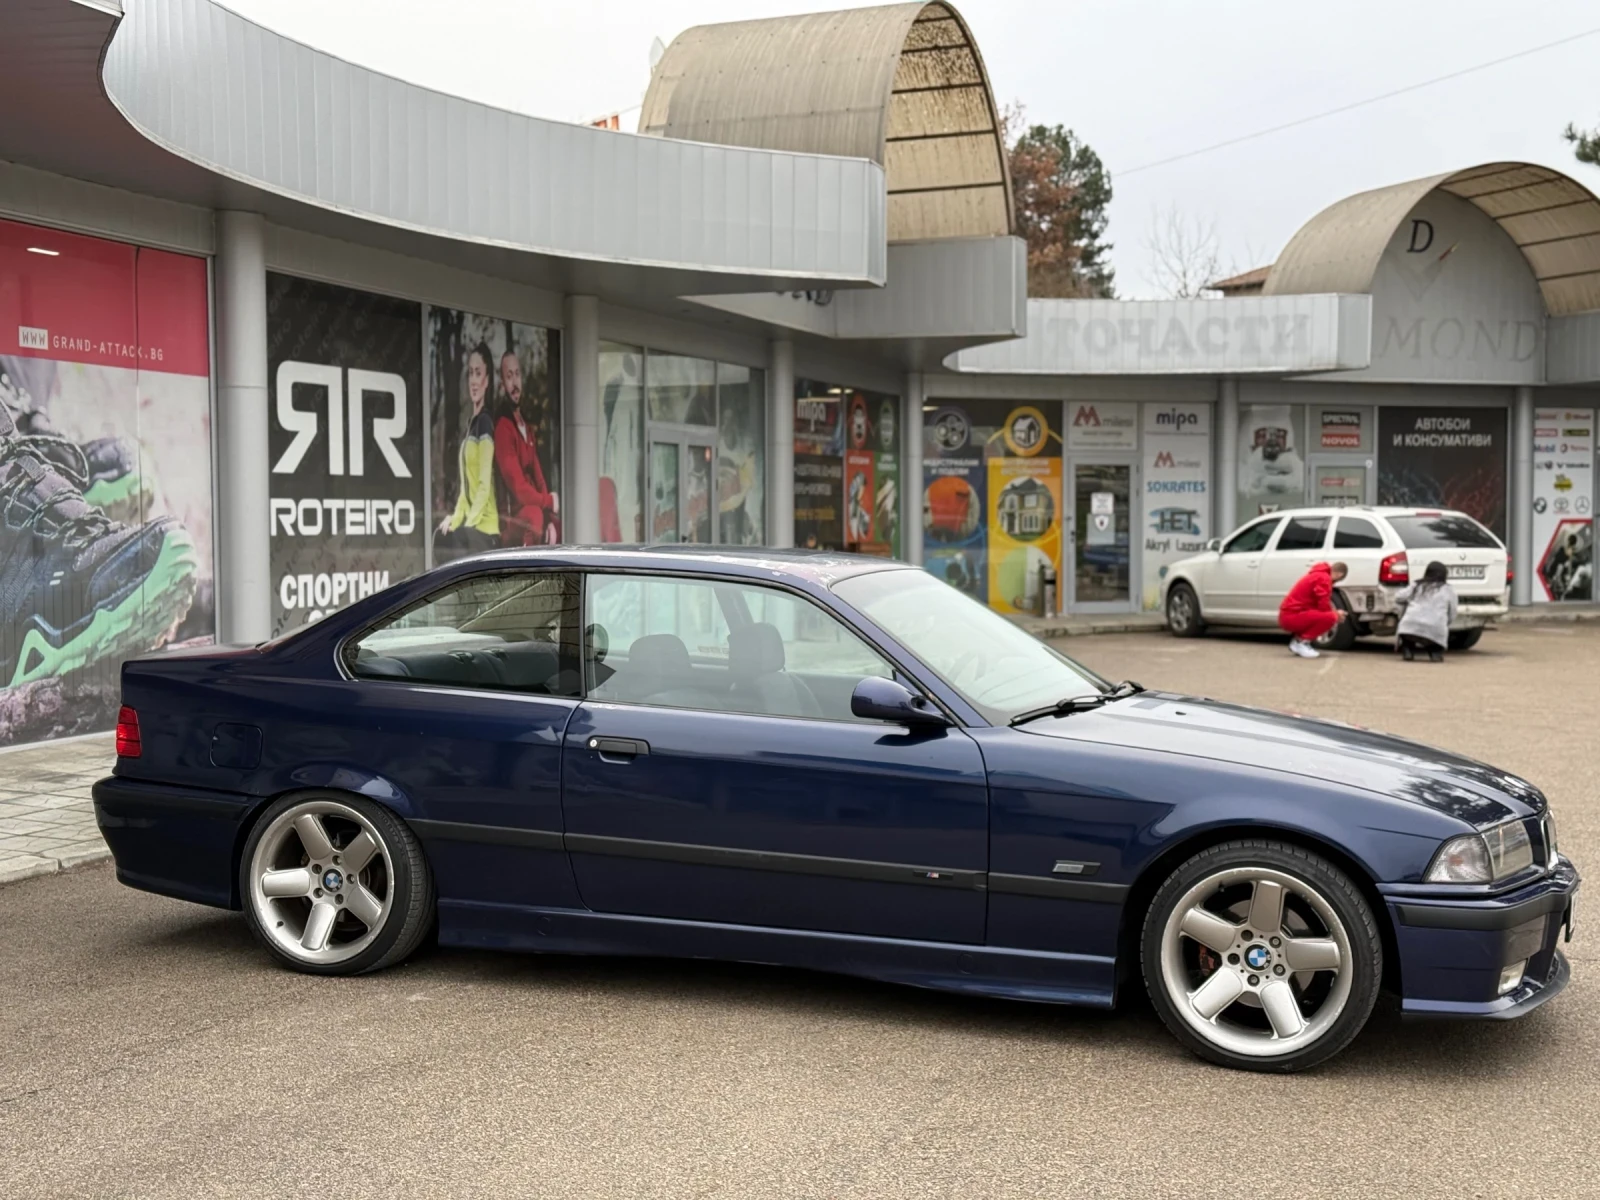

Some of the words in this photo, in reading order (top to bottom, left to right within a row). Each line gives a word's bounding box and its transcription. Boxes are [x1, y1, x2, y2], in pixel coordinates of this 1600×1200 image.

[1406, 219, 1435, 253] D
[22, 330, 46, 346] WWW
[1156, 408, 1198, 431] mipa
[1414, 417, 1472, 431] АВТОБОИ
[1322, 436, 1360, 447] NOVOL
[1393, 434, 1403, 447] И
[1405, 433, 1492, 447] КОНСУМАТИВИ
[1147, 480, 1207, 493] SOKRATES
[270, 498, 415, 536] ROTEIRO
[1158, 509, 1198, 531] HET
[1145, 538, 1171, 554] Akryl
[280, 571, 390, 610] СПОРТНИ
